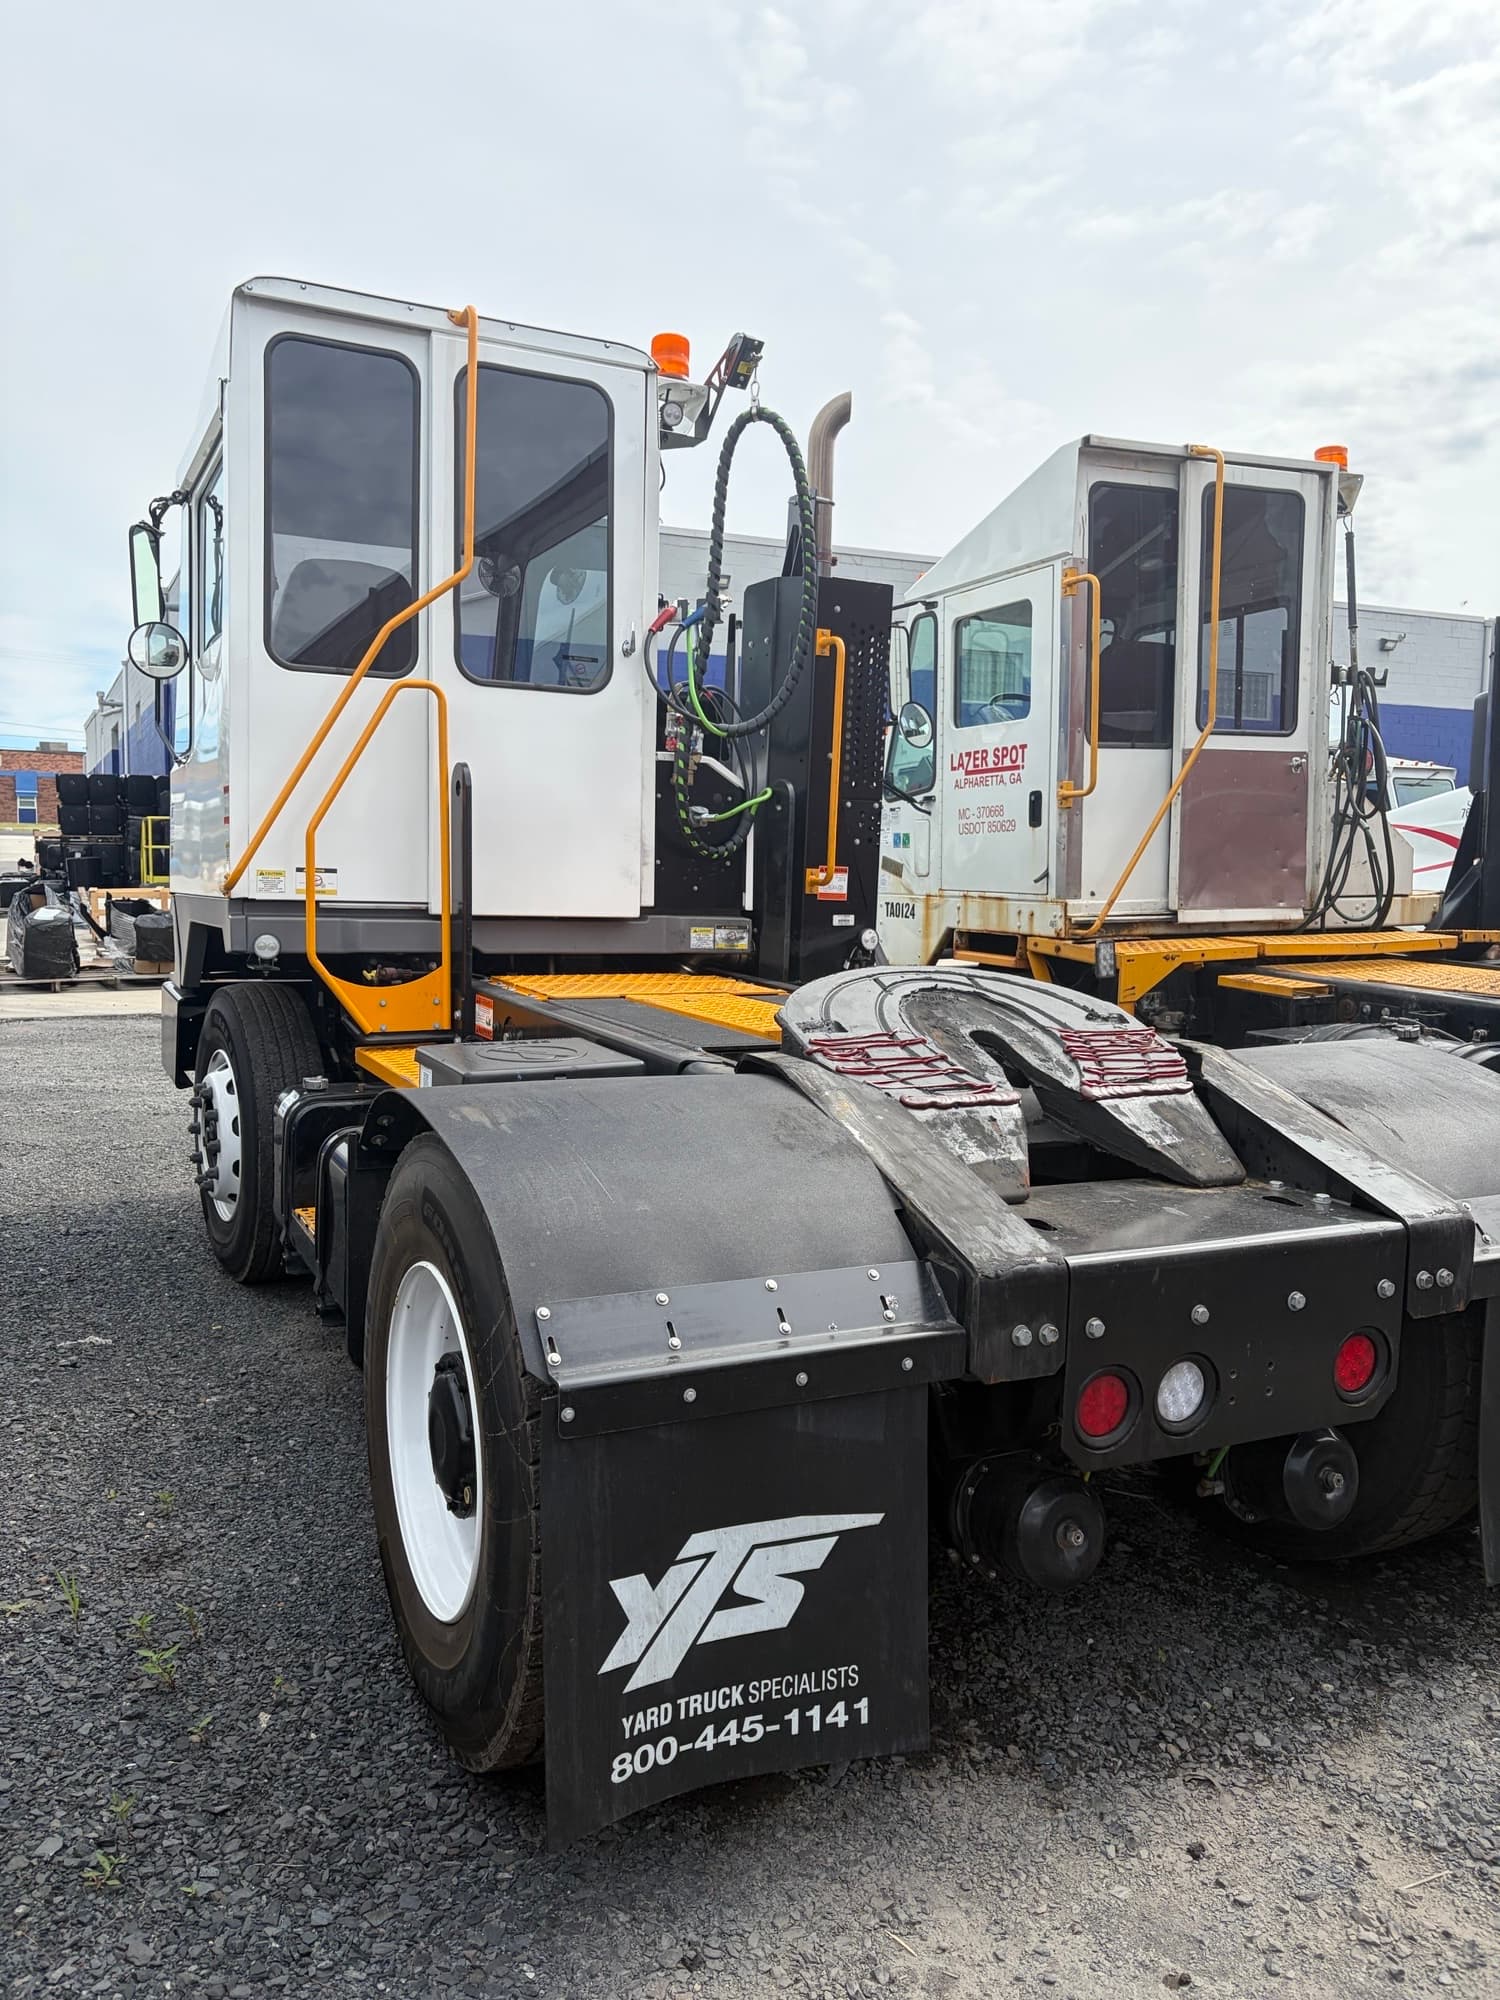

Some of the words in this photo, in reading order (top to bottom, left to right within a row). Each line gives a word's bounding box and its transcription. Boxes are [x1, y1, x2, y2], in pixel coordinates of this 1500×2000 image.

[950, 749, 988, 775] LAZER
[992, 743, 1027, 770] SPOT
[954, 774, 1007, 790] ALPHARETTA,
[1009, 772, 1023, 785] GA
[958, 807, 971, 821] MC
[977, 804, 1005, 819] 370668
[958, 821, 986, 836] USDOT
[987, 819, 1017, 834] 850629
[885, 901, 916, 919] TA0124
[597, 1512, 886, 1694] YTS
[621, 1706, 673, 1740] YARD
[678, 1683, 745, 1721] TRUCK
[748, 1664, 860, 1704] SPECIALISTS
[610, 1697, 870, 1784] 800-445-1141
